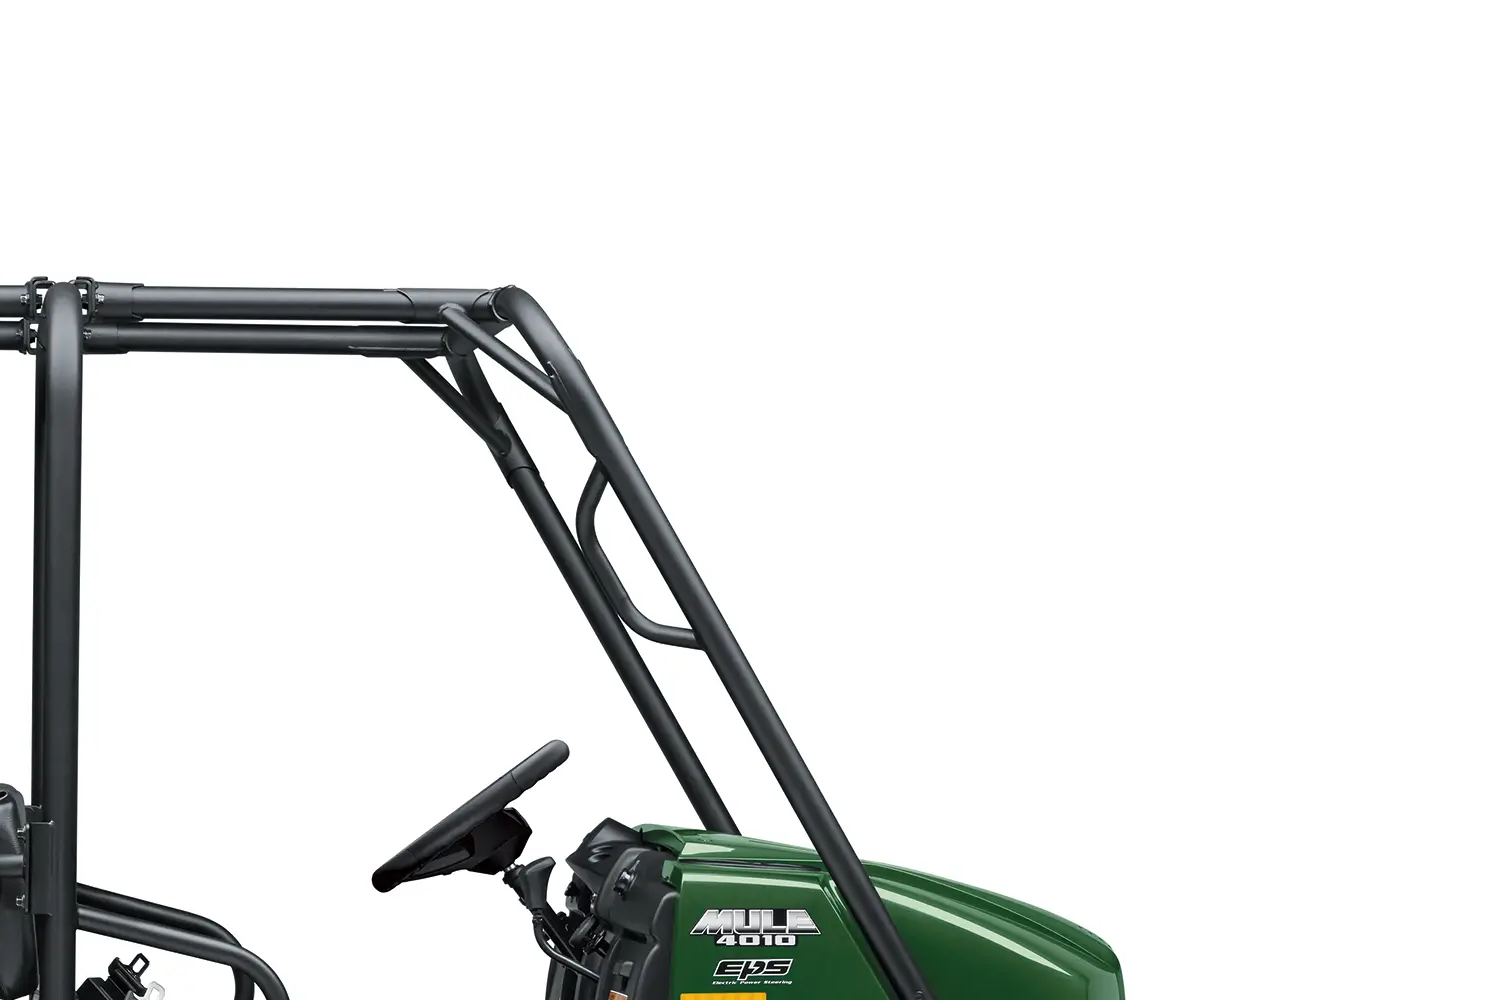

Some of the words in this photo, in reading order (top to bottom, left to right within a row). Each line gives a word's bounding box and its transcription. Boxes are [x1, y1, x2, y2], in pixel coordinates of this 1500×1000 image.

[689, 909, 821, 935] MULE
[716, 935, 797, 946] 4010
[713, 959, 793, 981] EPS
